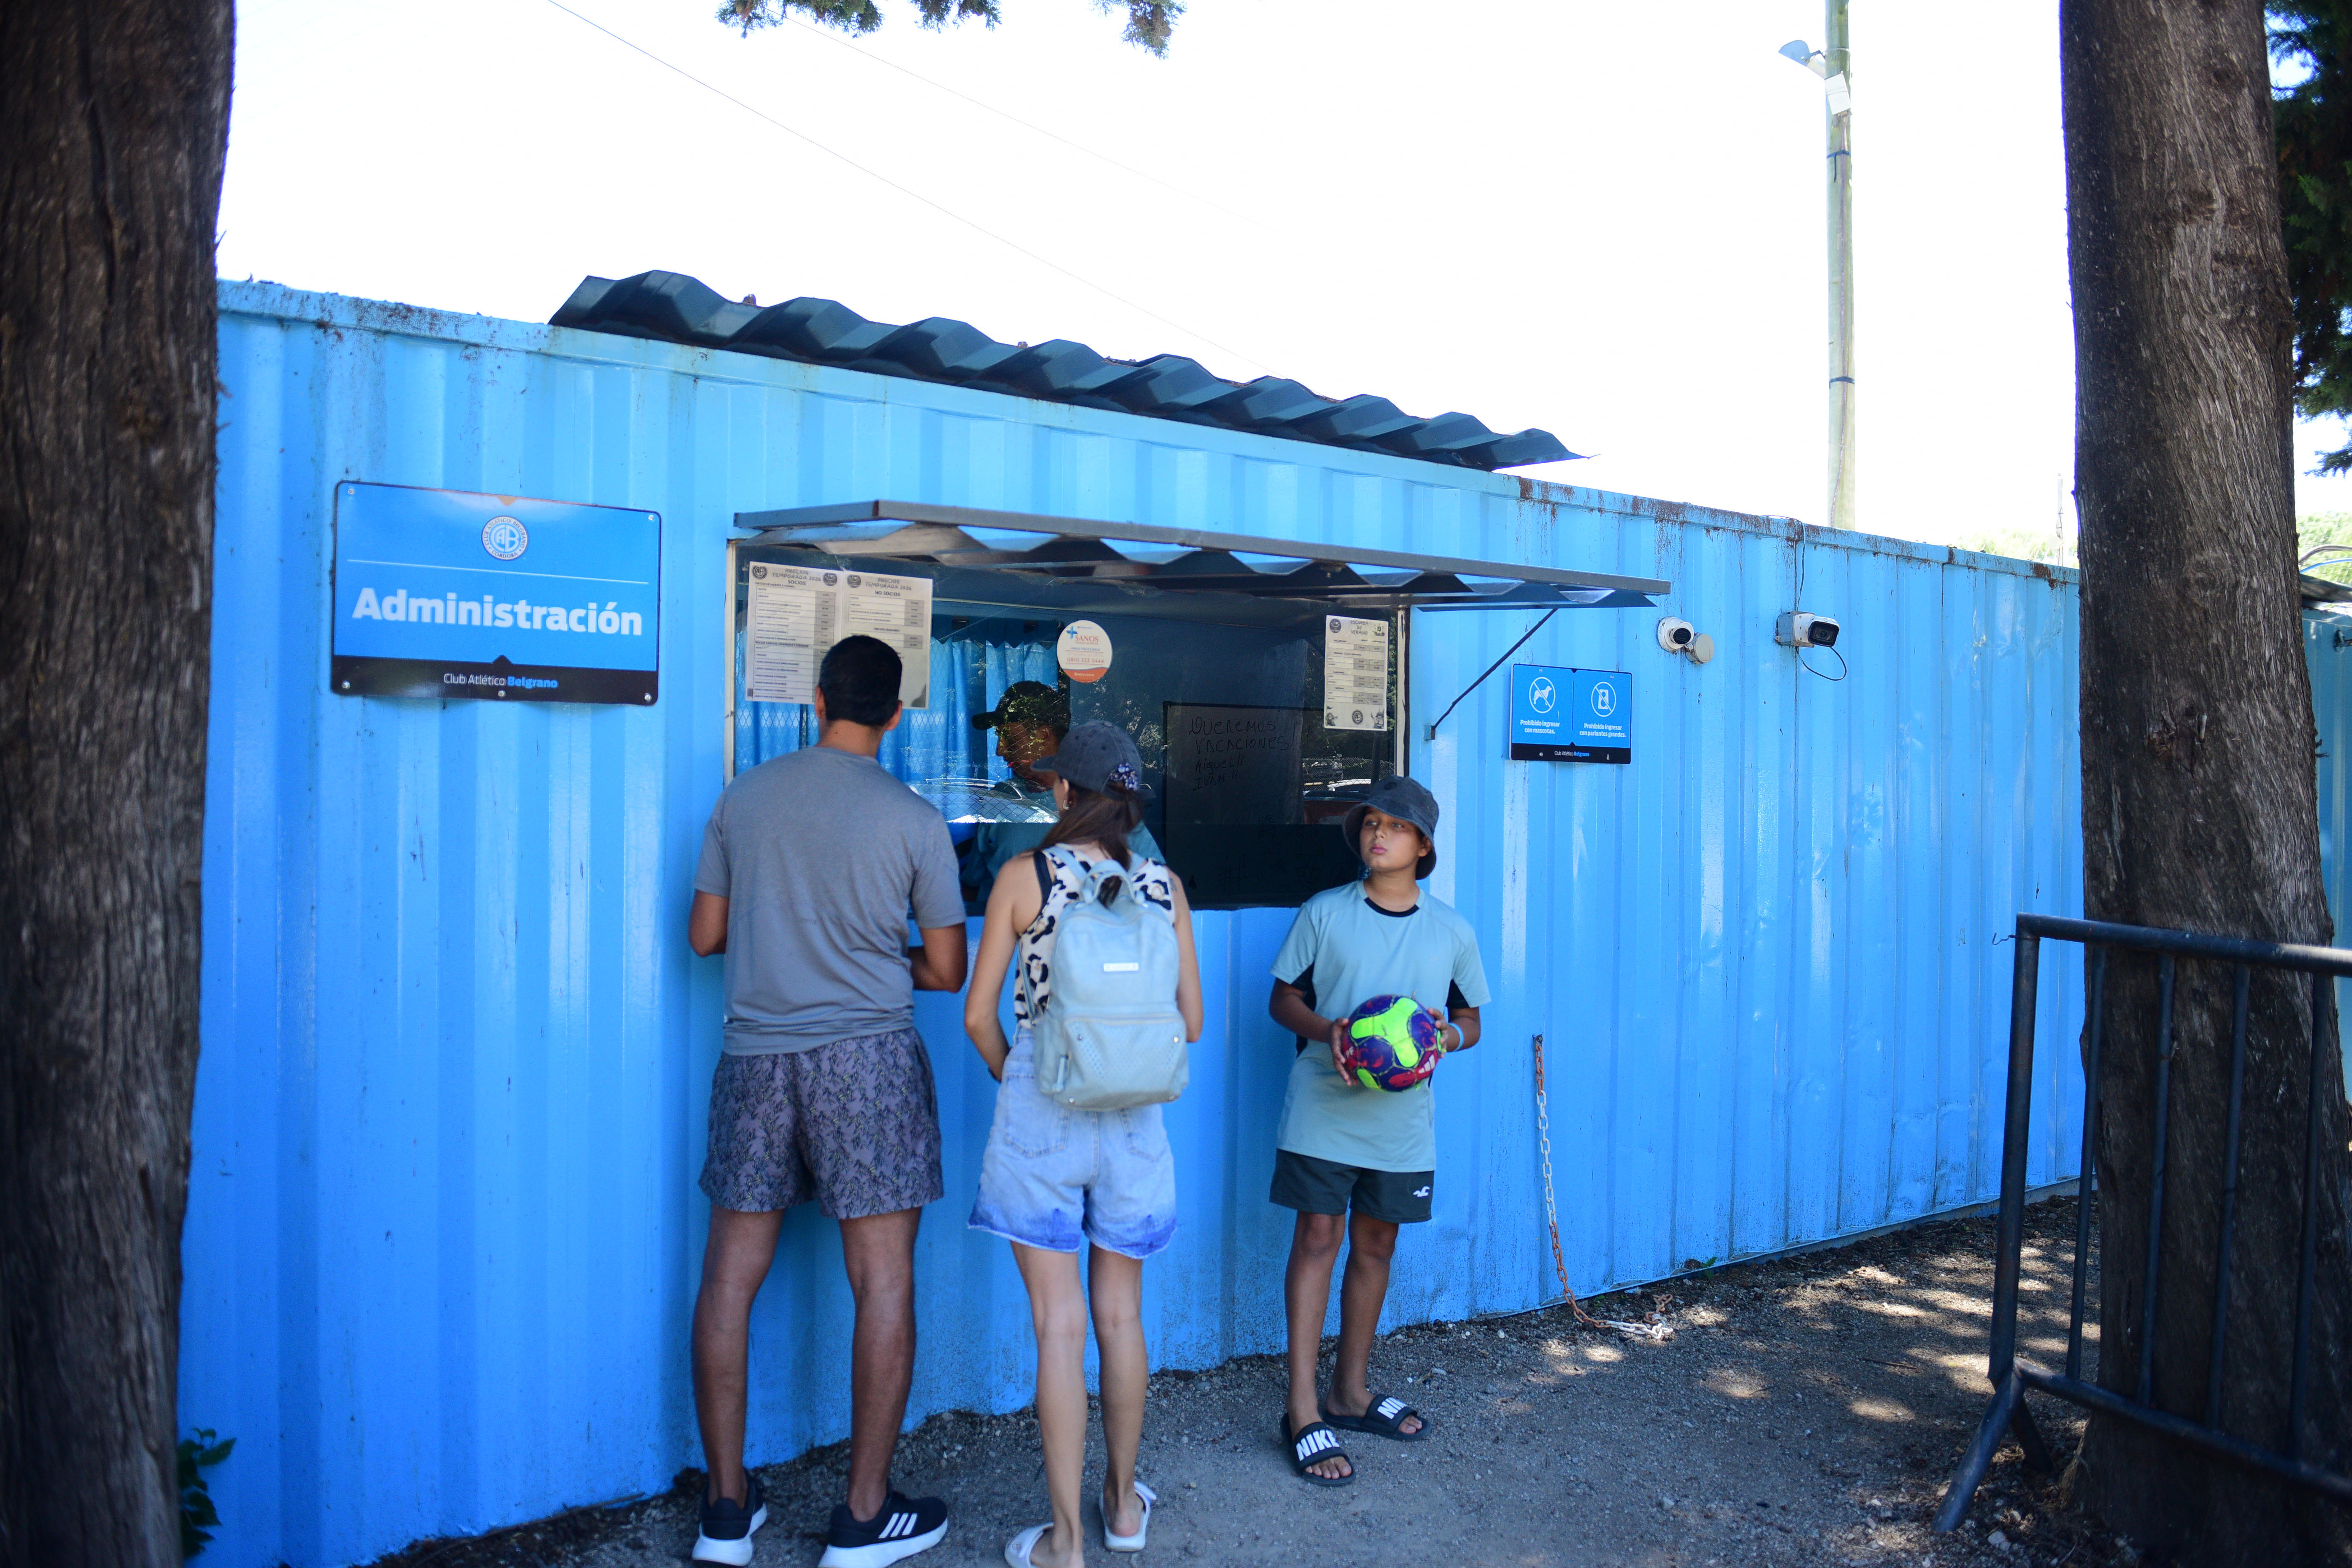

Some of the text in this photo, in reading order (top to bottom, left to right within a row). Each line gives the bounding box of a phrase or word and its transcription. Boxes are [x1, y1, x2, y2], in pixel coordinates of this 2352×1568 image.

[512, 521, 527, 548] BELGRANO
[491, 549, 518, 559] CORDOBA
[352, 587, 643, 636] Administración
[444, 673, 559, 688] Club Atlético Belgrano
[1296, 1429, 1340, 1461] NIKE
